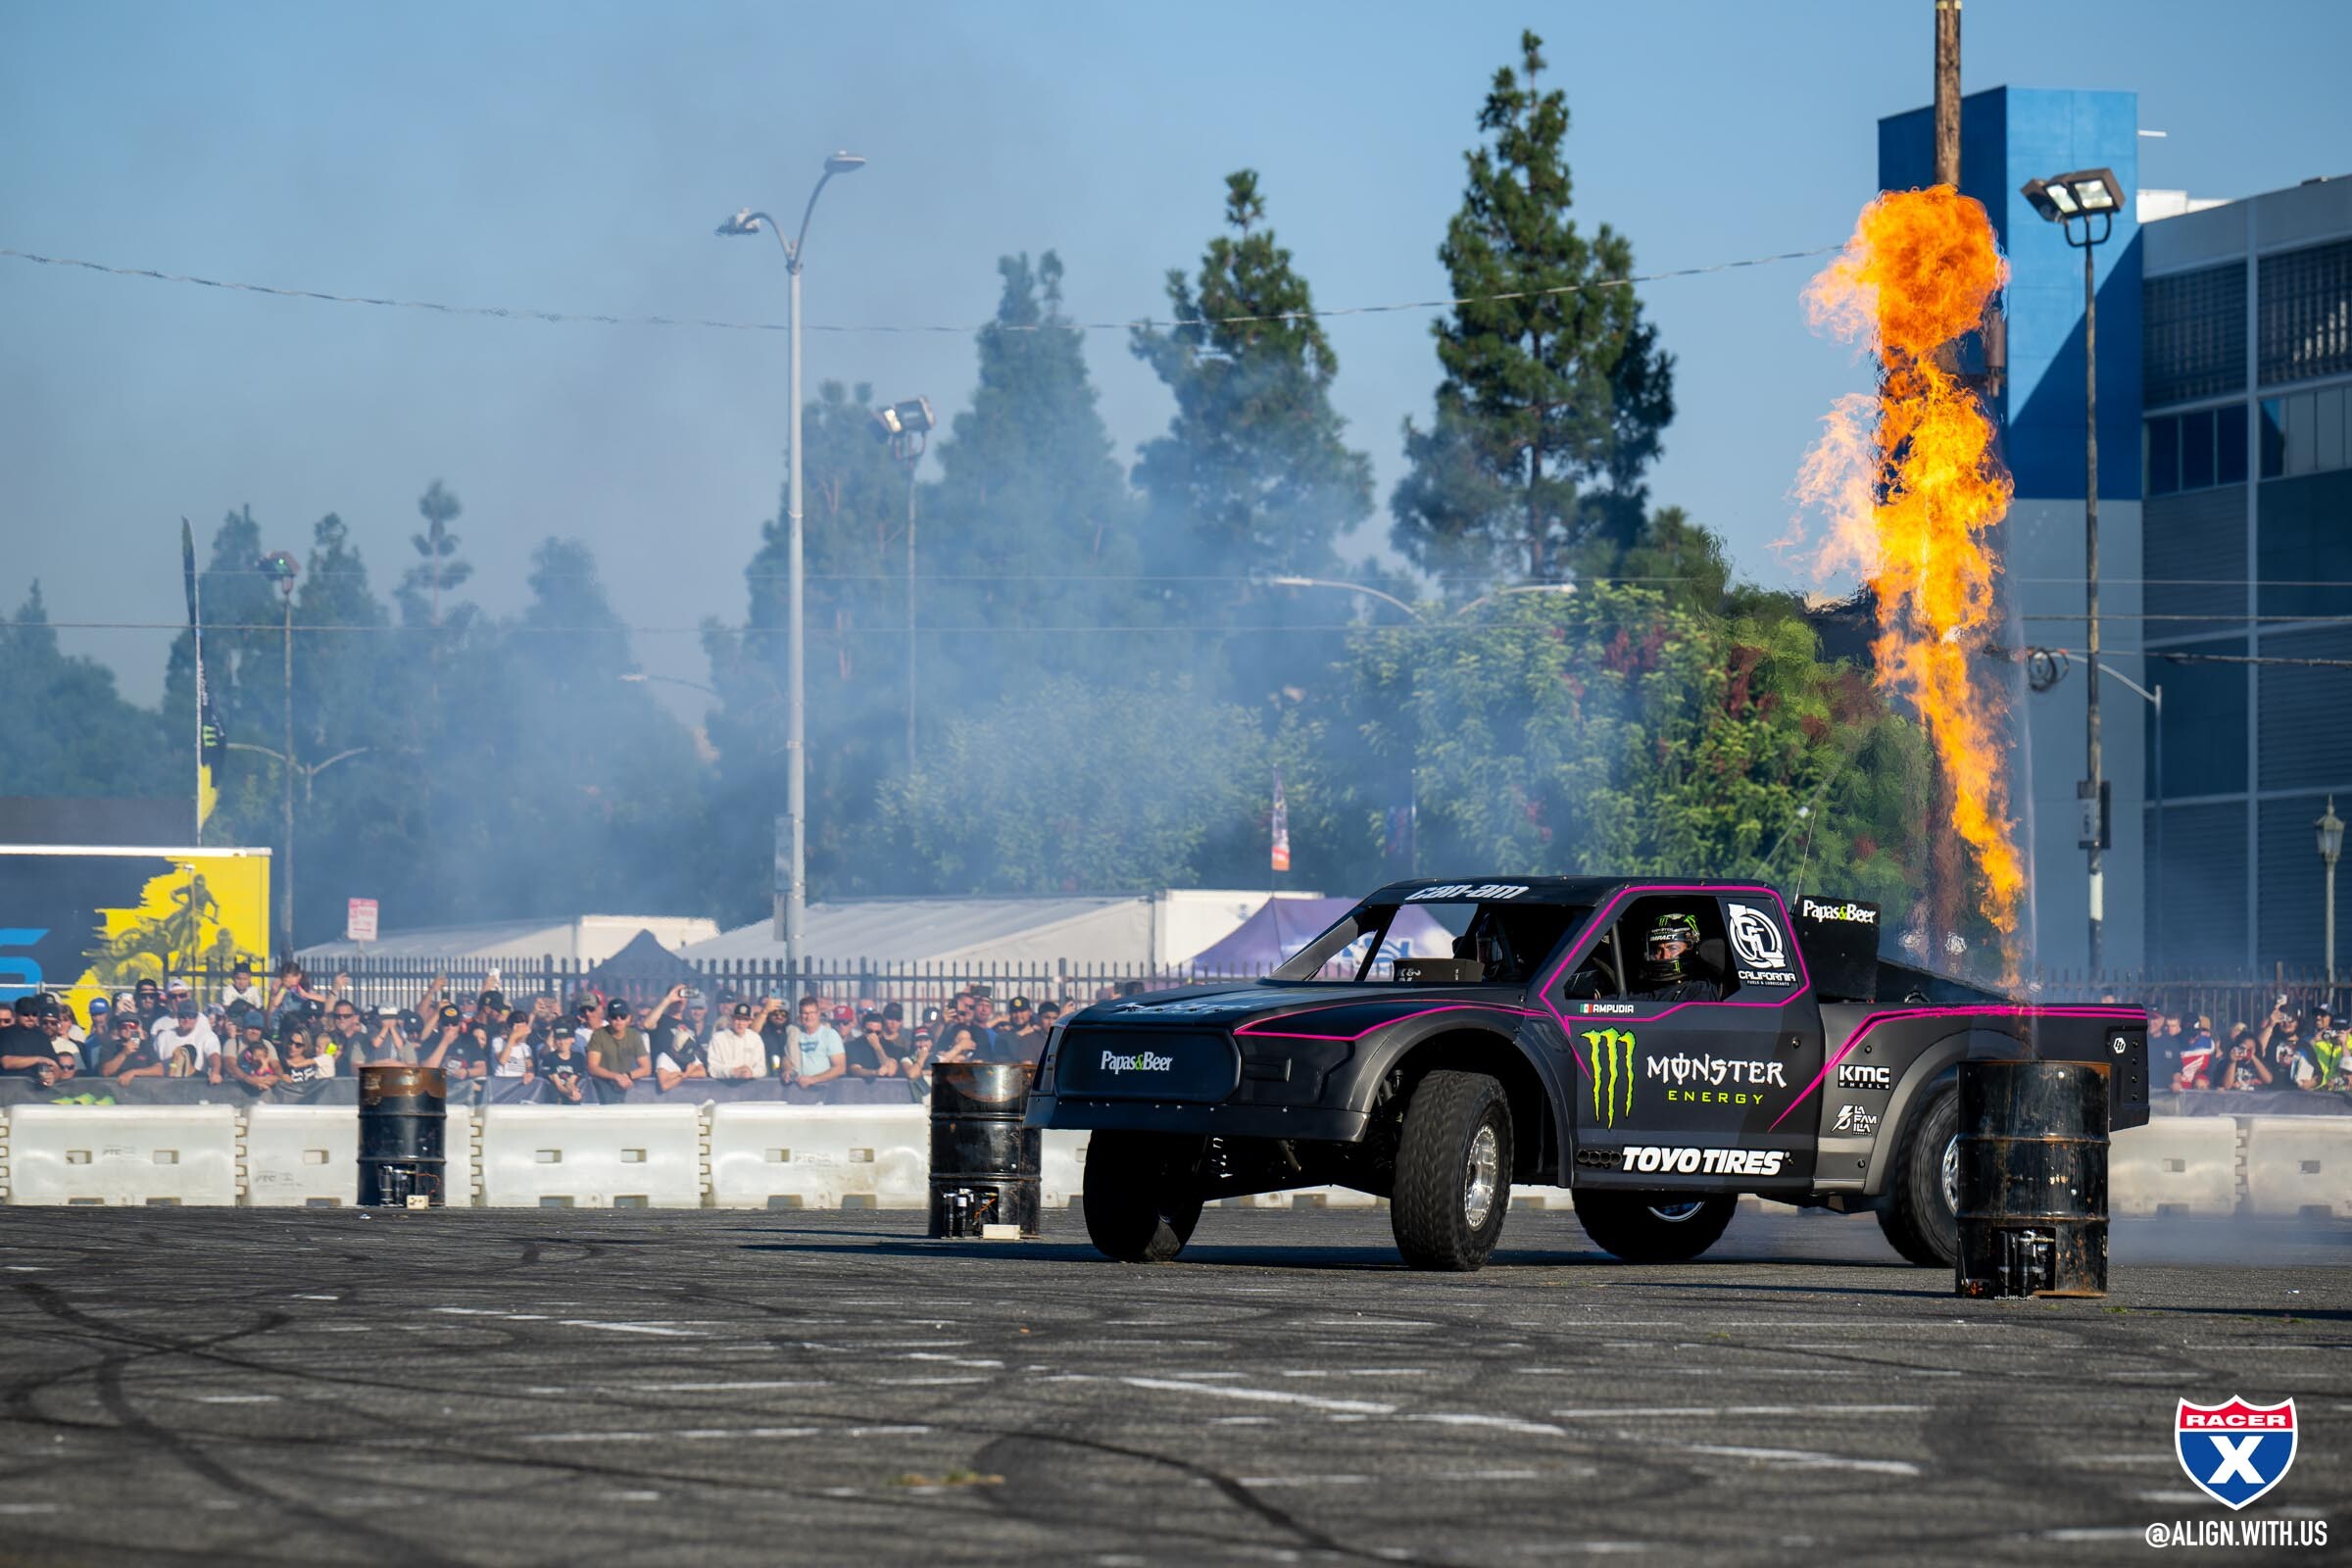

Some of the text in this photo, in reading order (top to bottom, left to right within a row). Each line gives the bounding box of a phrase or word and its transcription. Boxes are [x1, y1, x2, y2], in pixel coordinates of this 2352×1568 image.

[1802, 899, 1877, 924] Papas&Beer
[1739, 970, 1796, 982] CALIFORNIA
[1592, 1004, 1635, 1014] AMPUDIA
[1101, 1050, 1173, 1075] Papas&Beer
[1646, 1052, 1788, 1089] MONSTER
[1838, 1064, 1890, 1083] KMC
[1668, 1090, 1764, 1104] ENERGY
[1854, 1105, 1866, 1115] LA
